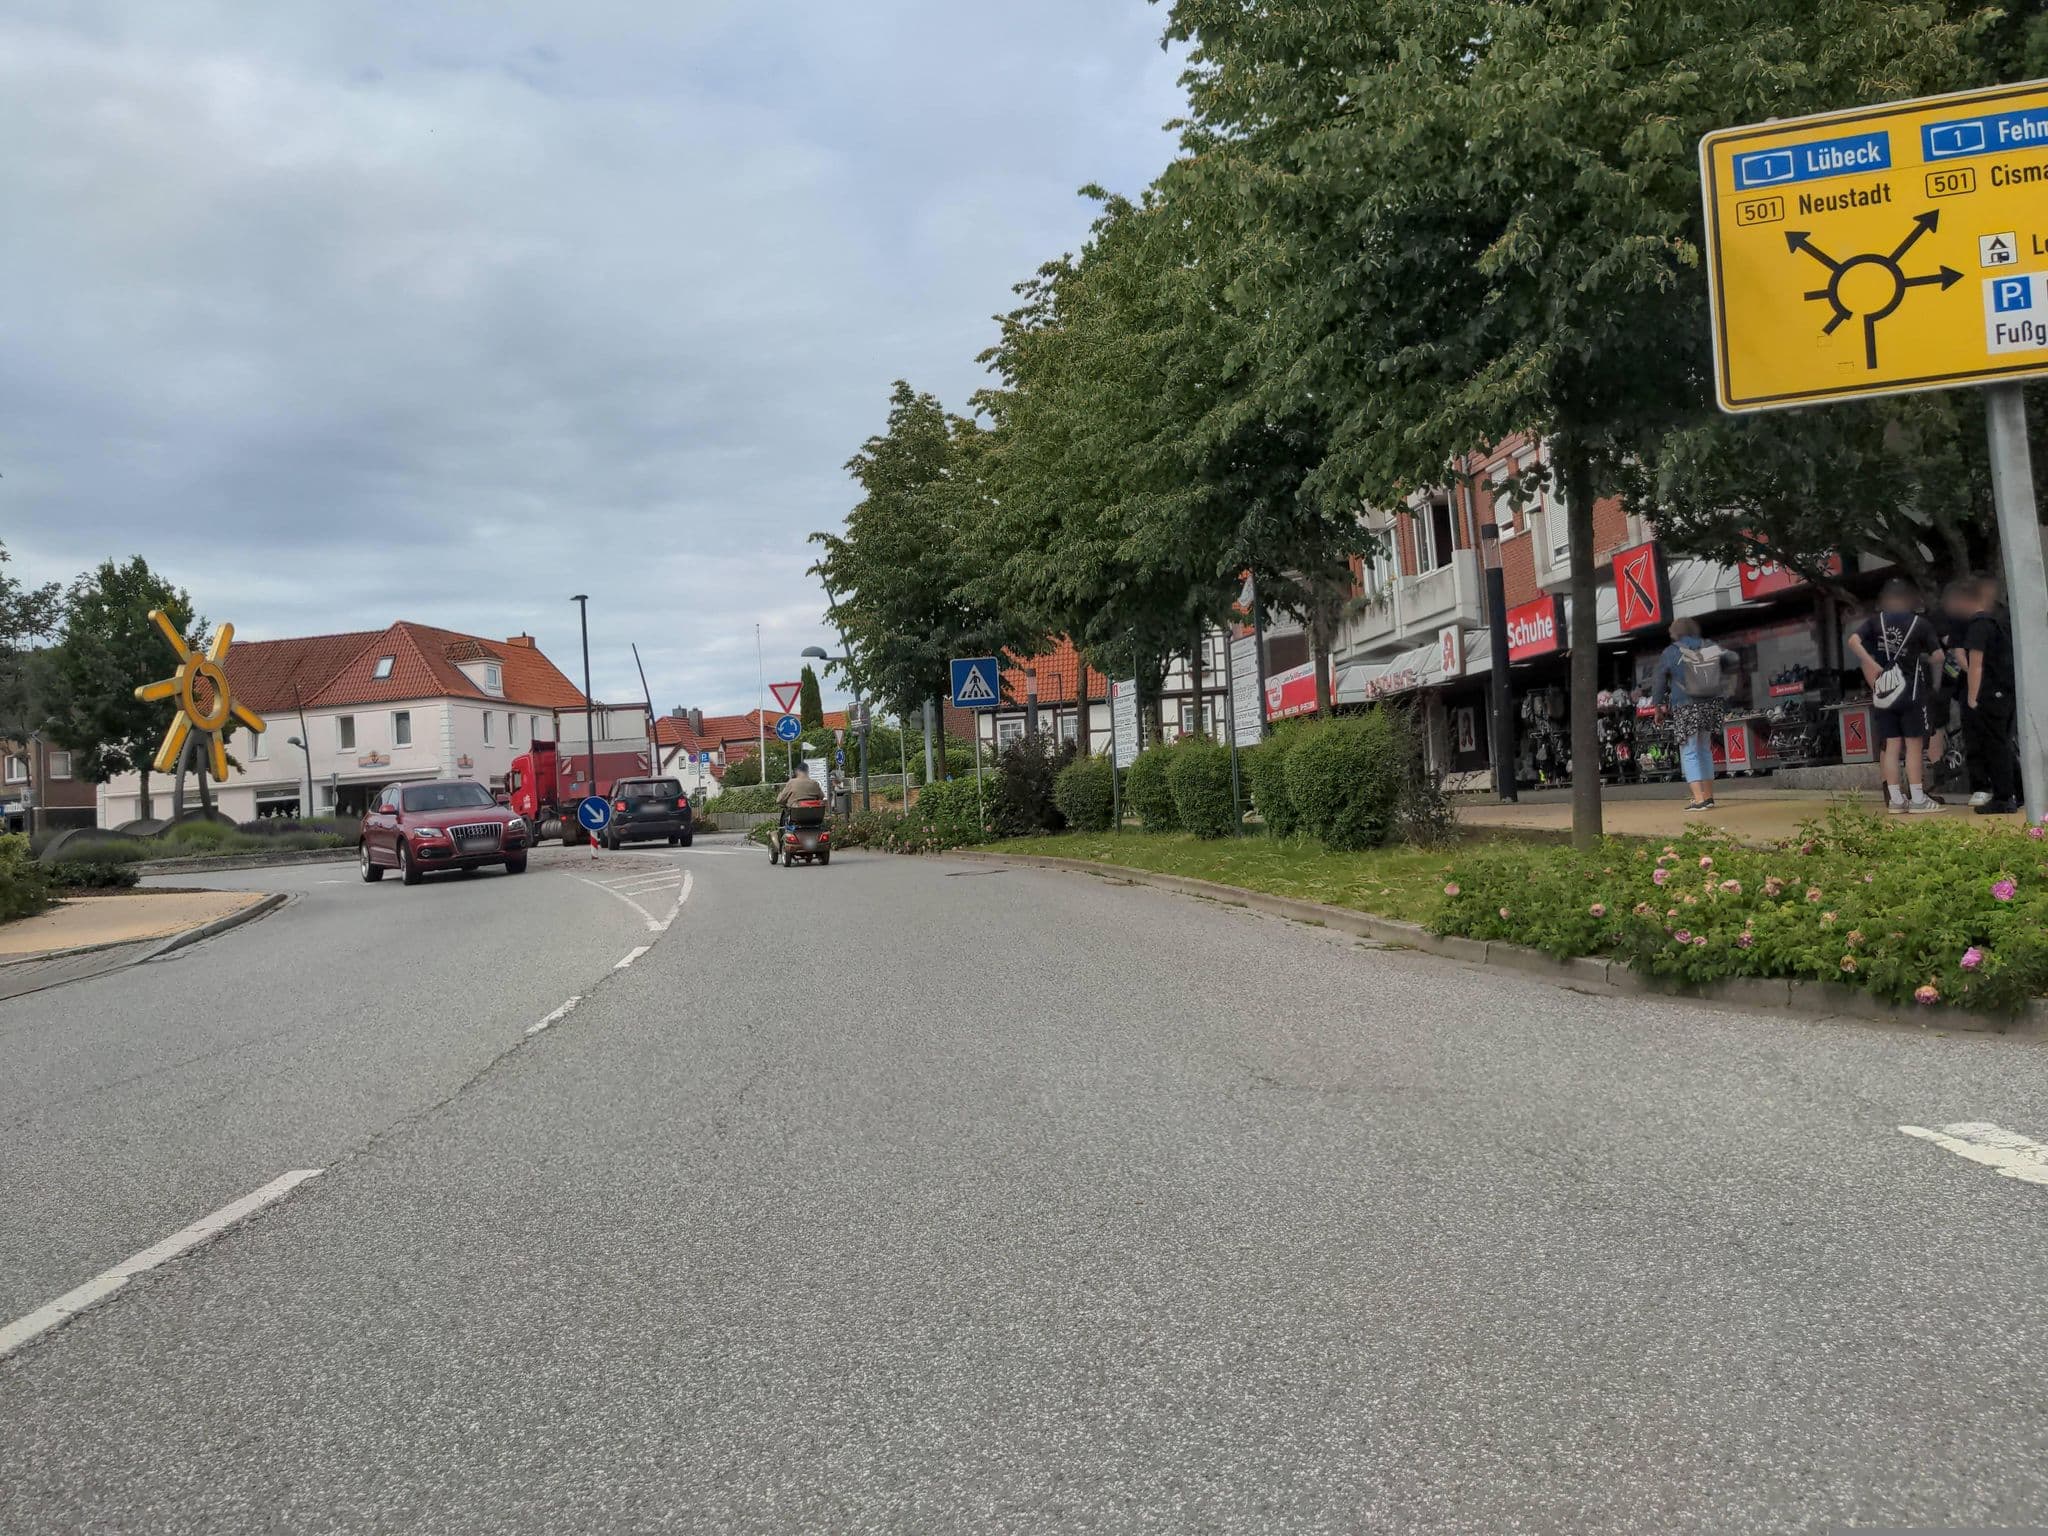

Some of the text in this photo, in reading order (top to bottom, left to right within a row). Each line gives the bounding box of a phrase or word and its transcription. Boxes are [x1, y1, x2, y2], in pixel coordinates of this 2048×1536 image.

[1954, 130, 1962, 147] 1
[1764, 141, 1882, 176] 1 Lübeck
[1934, 173, 1967, 193] 501
[1744, 183, 1892, 221] 501 Neustadt
[1507, 612, 1553, 649] Schuhe
